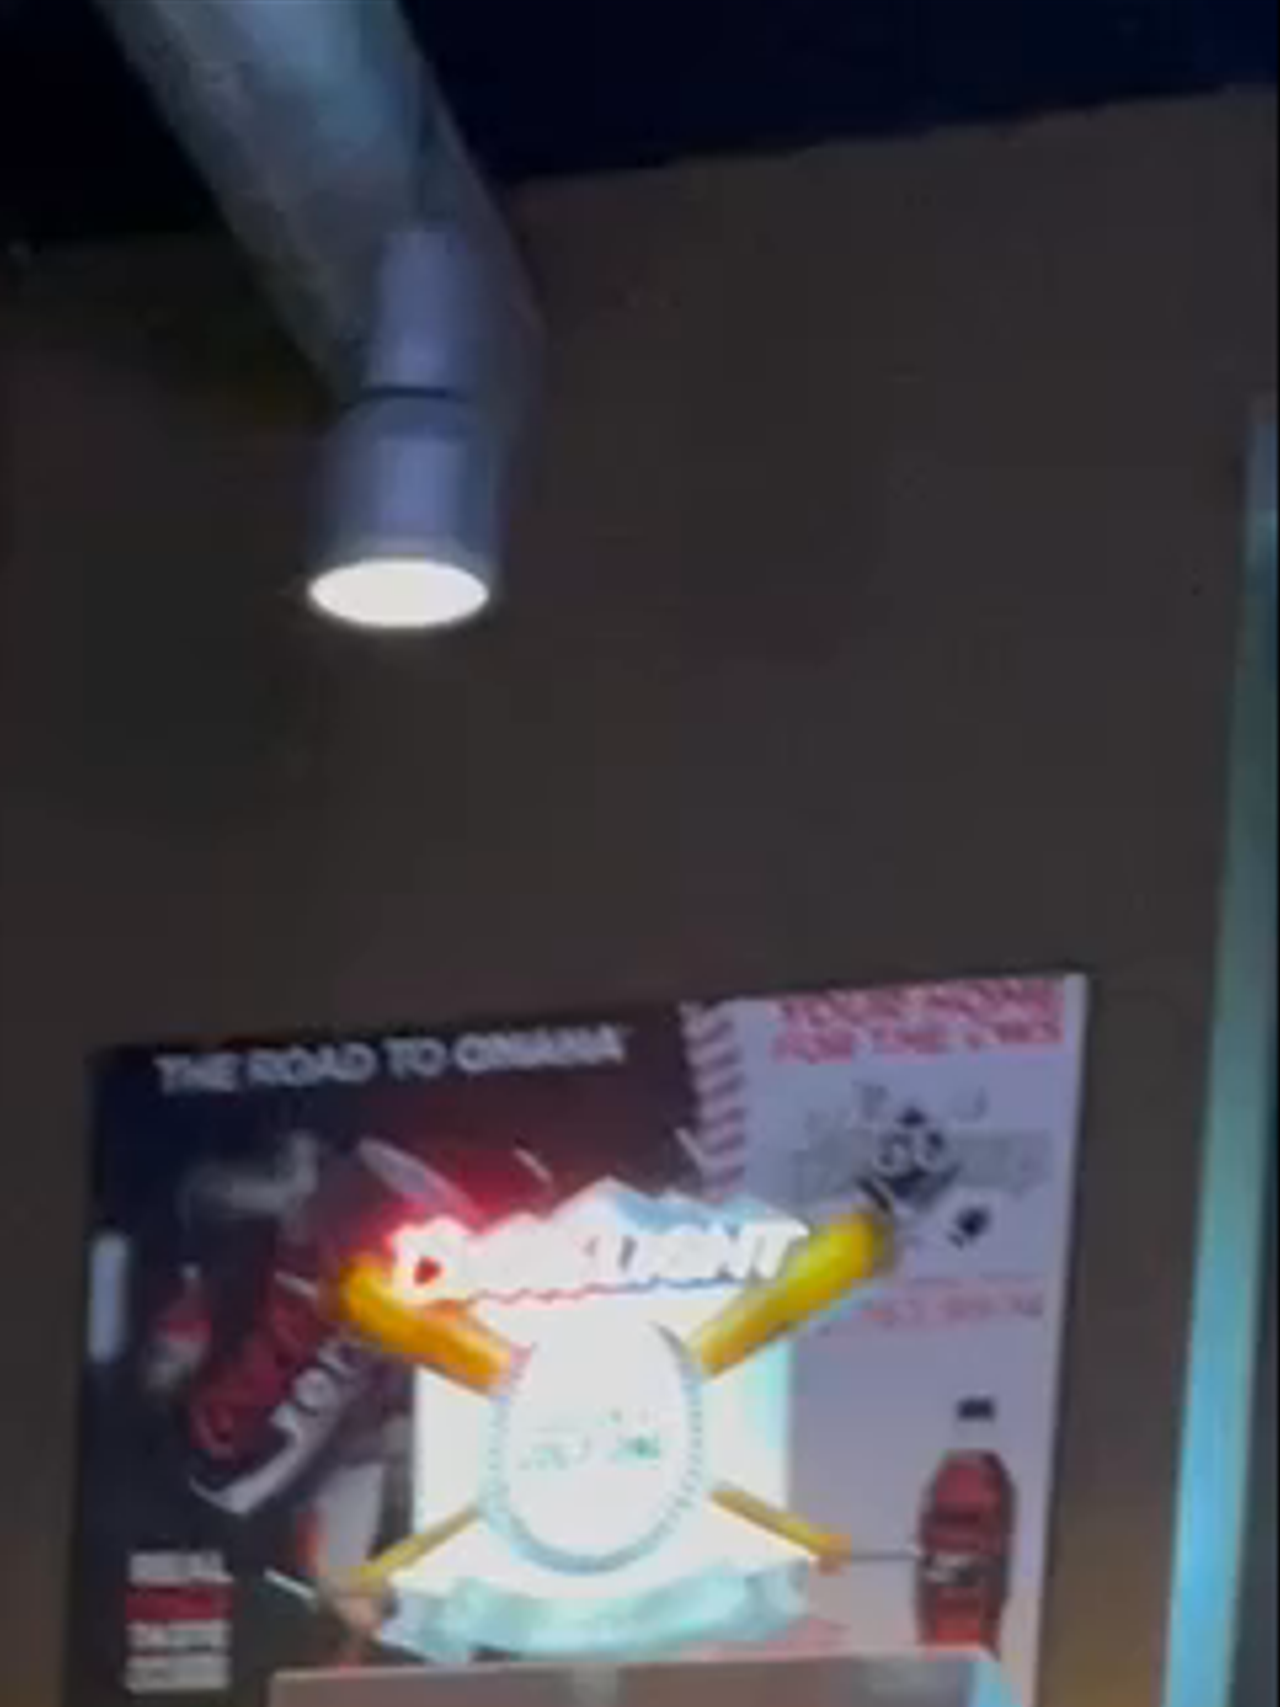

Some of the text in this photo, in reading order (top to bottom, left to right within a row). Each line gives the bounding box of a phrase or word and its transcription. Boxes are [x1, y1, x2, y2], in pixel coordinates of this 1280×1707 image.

[154, 1023, 626, 1094] THE ROAD TO OMAHA
